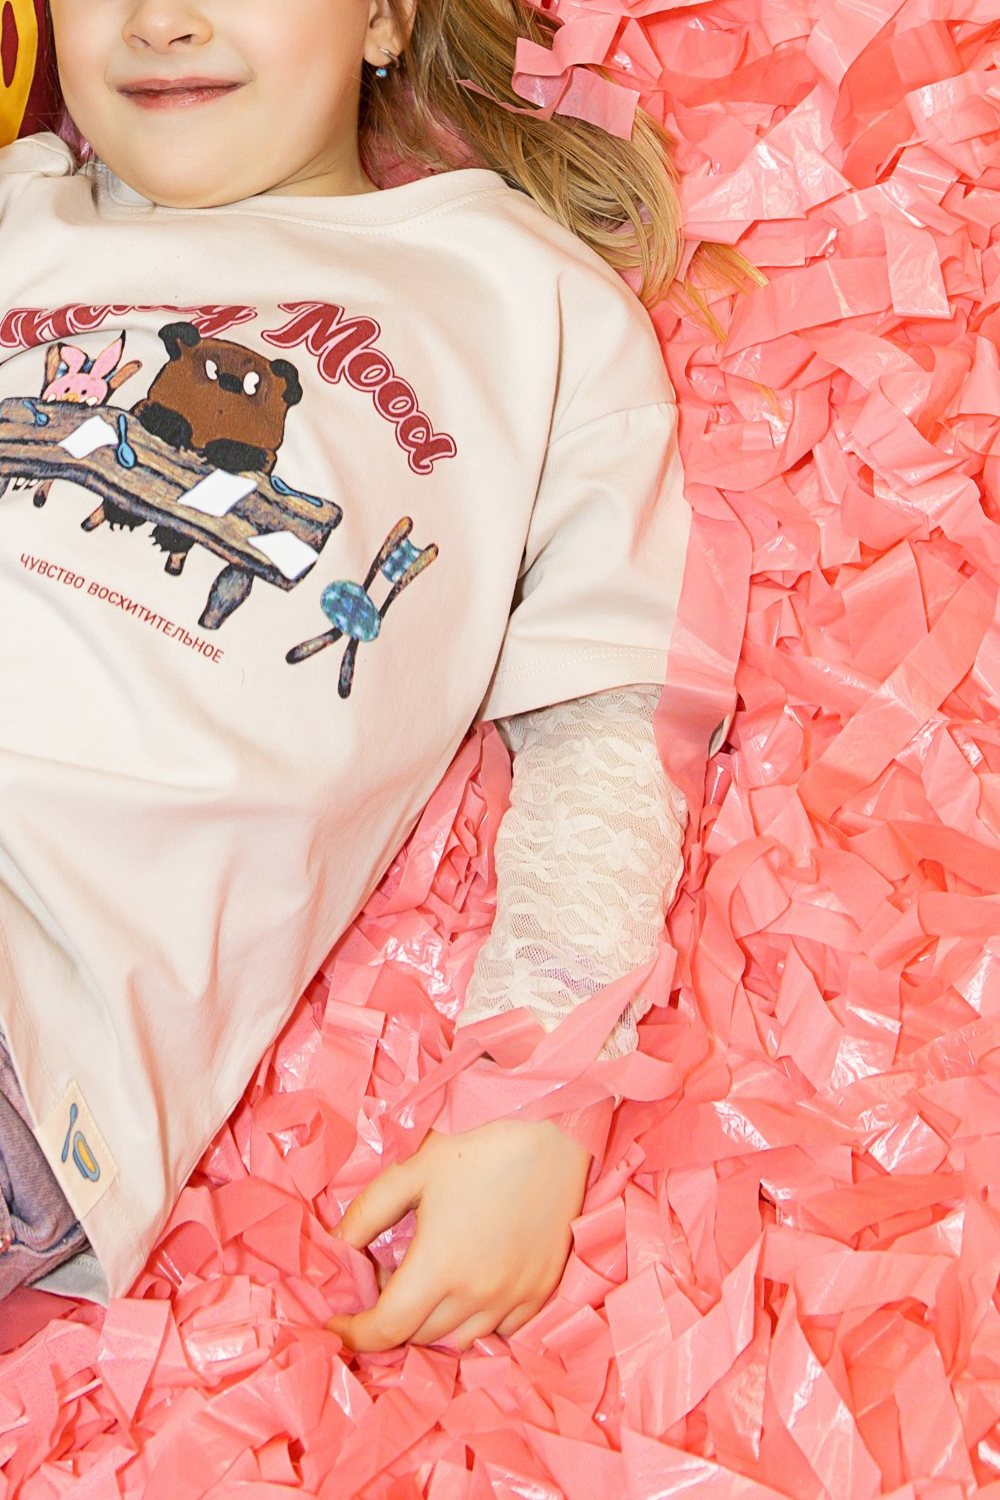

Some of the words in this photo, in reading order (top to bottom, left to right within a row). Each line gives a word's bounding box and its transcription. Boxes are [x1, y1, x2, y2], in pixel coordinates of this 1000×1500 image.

[262, 301, 458, 475] Mood
[20, 552, 85, 589] ЧУВСТВО
[87, 582, 224, 664] ВОСХИТИТЕЛЬНОЕ
